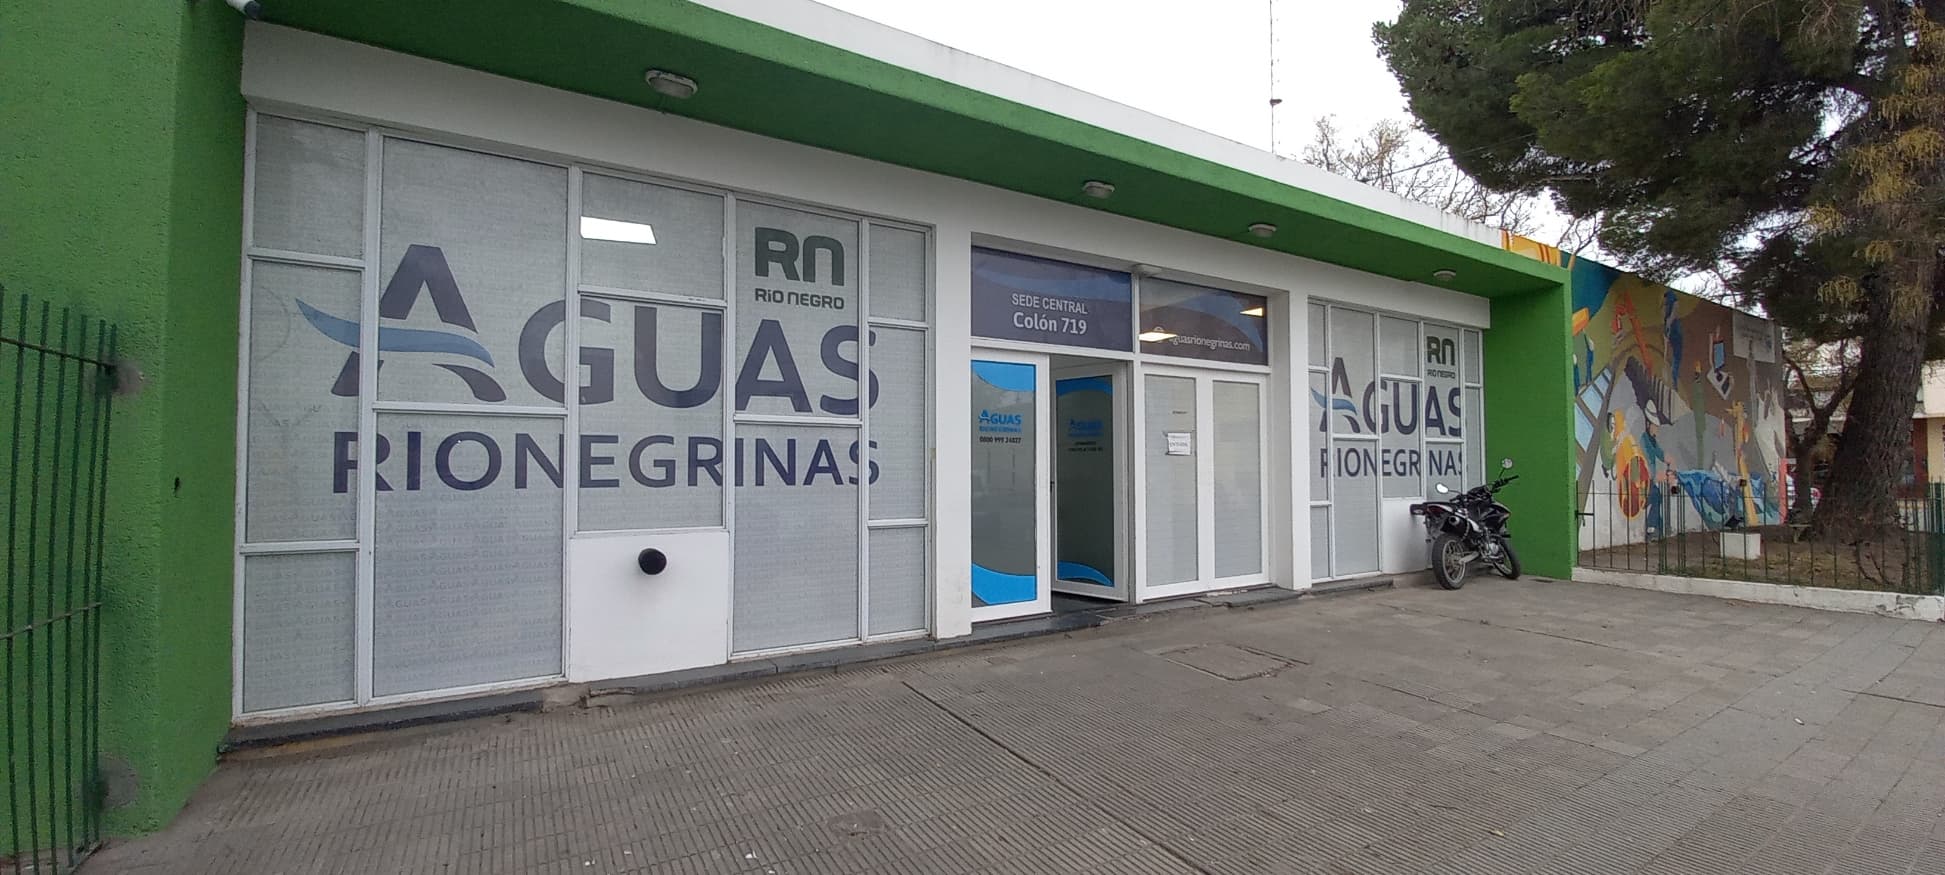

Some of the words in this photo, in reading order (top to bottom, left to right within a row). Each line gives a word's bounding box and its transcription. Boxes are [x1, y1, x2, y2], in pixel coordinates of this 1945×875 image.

[787, 291, 845, 310] NEGRO
[1011, 293, 1040, 308] SEDE
[1042, 297, 1088, 314] CENTRAL
[295, 244, 881, 415] AGUAS
[1013, 311, 1057, 332] Colón
[1061, 317, 1088, 335] 719
[1311, 357, 1463, 437] AGUAS
[979, 409, 1022, 424] AGUAS
[332, 430, 881, 494] RIONEGRINAS
